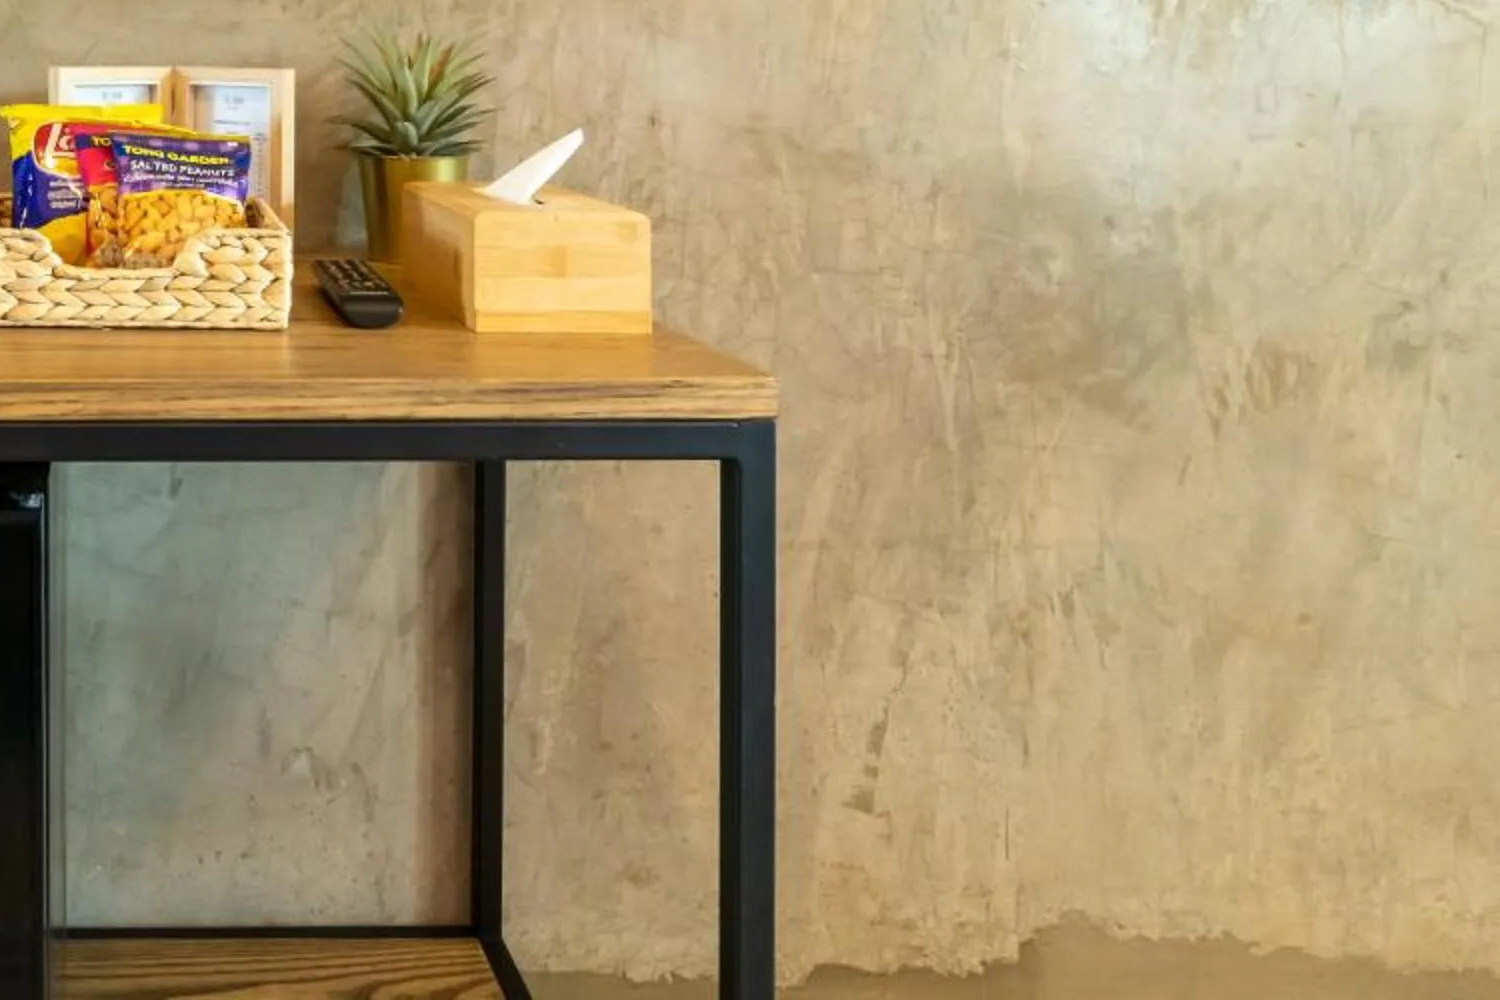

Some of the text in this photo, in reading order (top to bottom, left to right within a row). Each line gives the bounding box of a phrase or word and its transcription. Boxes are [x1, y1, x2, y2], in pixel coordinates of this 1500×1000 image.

[122, 144, 229, 165] TONG GARDEN
[130, 160, 235, 177] SALTED PEANUTS
